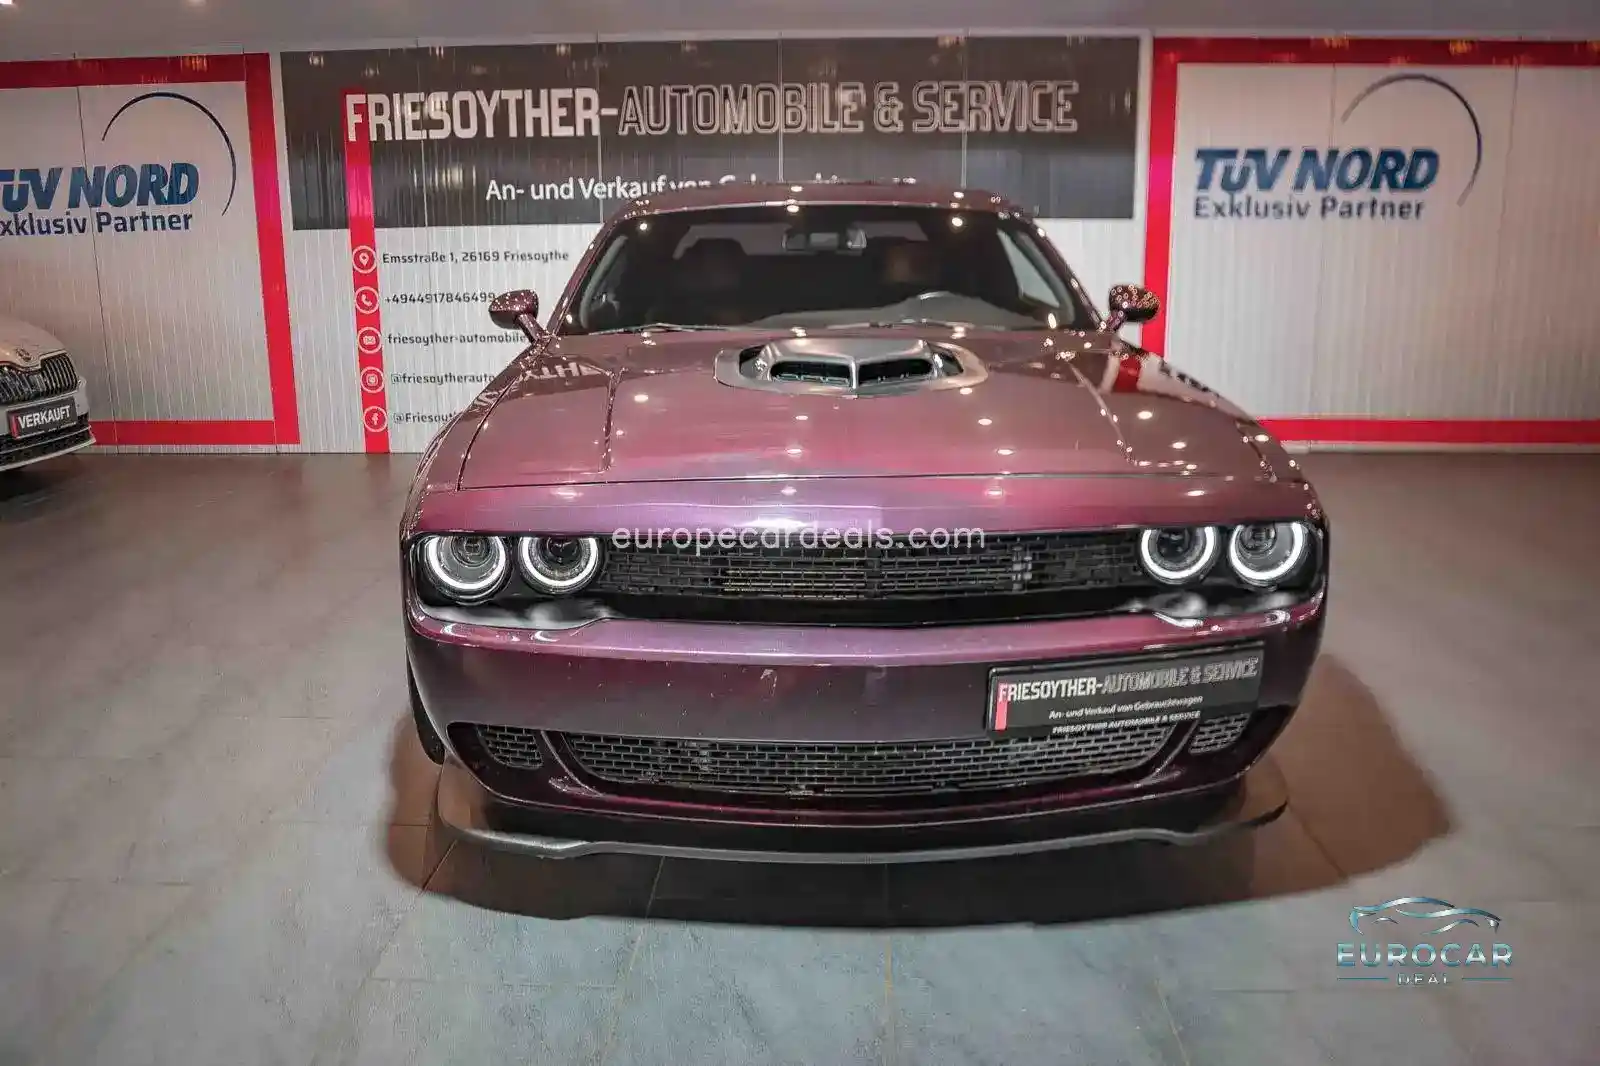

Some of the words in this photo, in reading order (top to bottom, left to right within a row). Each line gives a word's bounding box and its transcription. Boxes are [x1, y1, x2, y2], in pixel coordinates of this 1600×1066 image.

[345, 81, 864, 142] FRIESOYTHER-AUTOMOBILE
[873, 81, 905, 134] &
[911, 80, 1080, 134] SERVICE
[1293, 148, 1440, 193] NORD
[67, 162, 200, 209] NORD
[486, 179, 525, 200] An-
[530, 176, 575, 200] und
[577, 174, 667, 200] Verkauf
[1194, 196, 1312, 219] Exklusiv
[1320, 196, 1425, 219] Partner
[97, 212, 193, 233] Partner
[382, 251, 446, 264] Emsstraße
[449, 251, 459, 264] 1,
[462, 251, 500, 262] 26169
[504, 251, 569, 263] Friesoythe
[18, 405, 70, 429] VERKAUFT
[998, 667, 1190, 702] FRIESOYTHER-AUTOMOBILE
[1203, 657, 1259, 684] SERVICE
